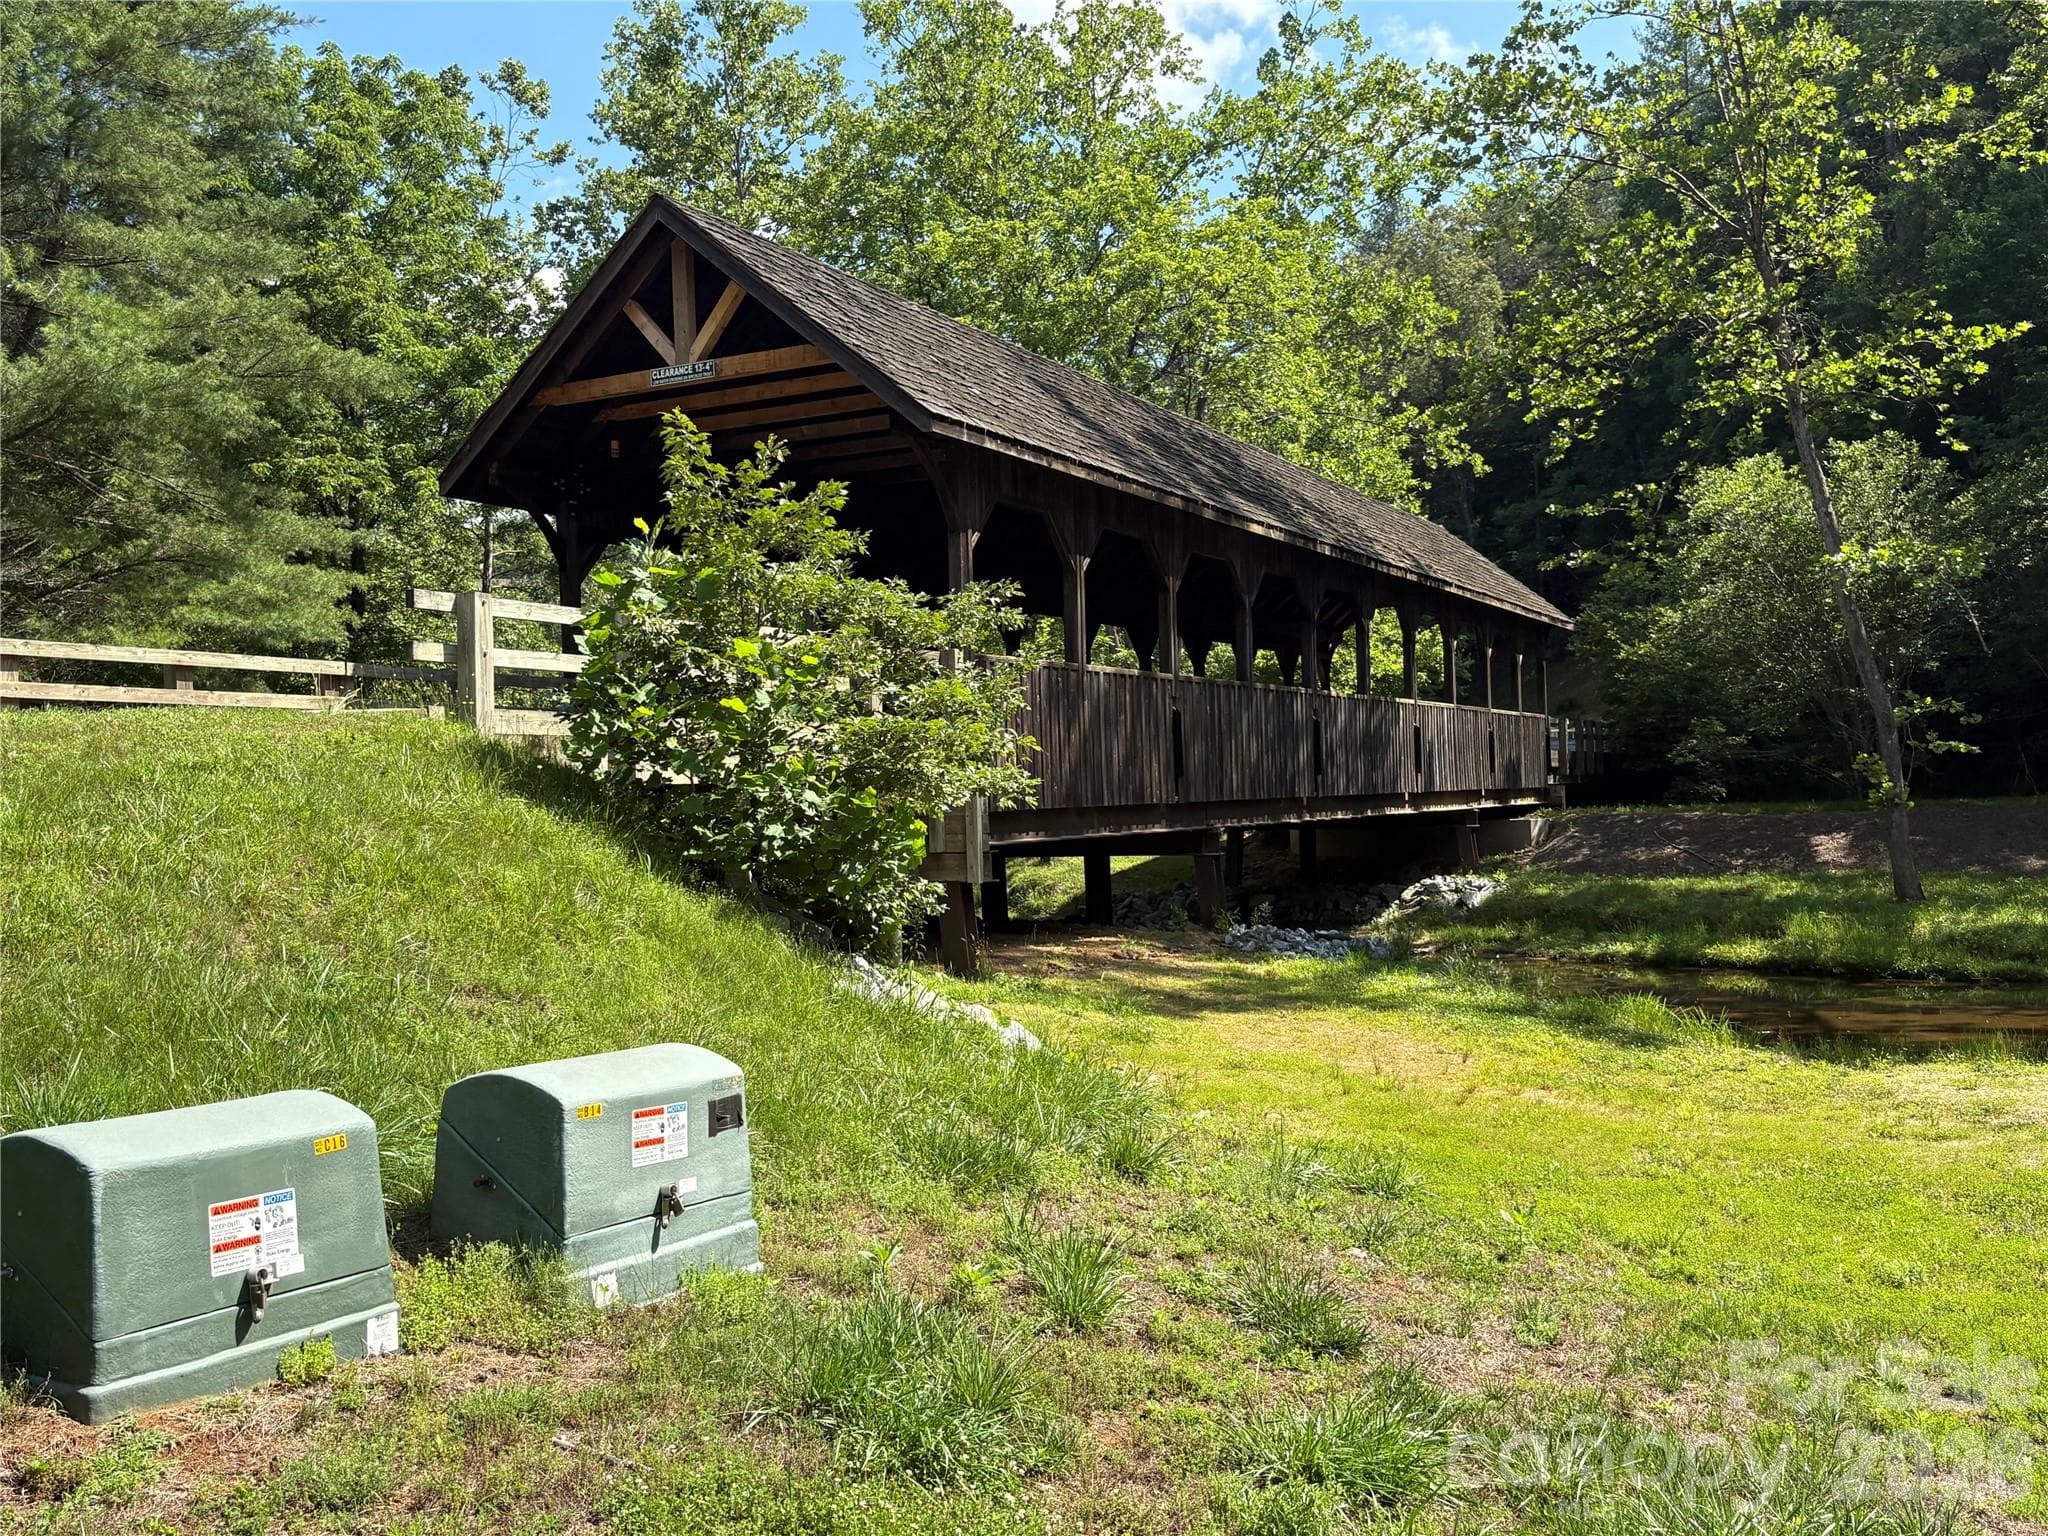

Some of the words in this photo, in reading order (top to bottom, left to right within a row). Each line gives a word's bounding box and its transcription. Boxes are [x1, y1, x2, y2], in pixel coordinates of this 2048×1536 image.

[652, 365, 693, 379] CLEARANCE
[324, 1135, 345, 1151] C16
[220, 1198, 259, 1214] WARNING
[264, 1191, 292, 1205] NOTICE
[221, 1235, 261, 1251] WARNING
